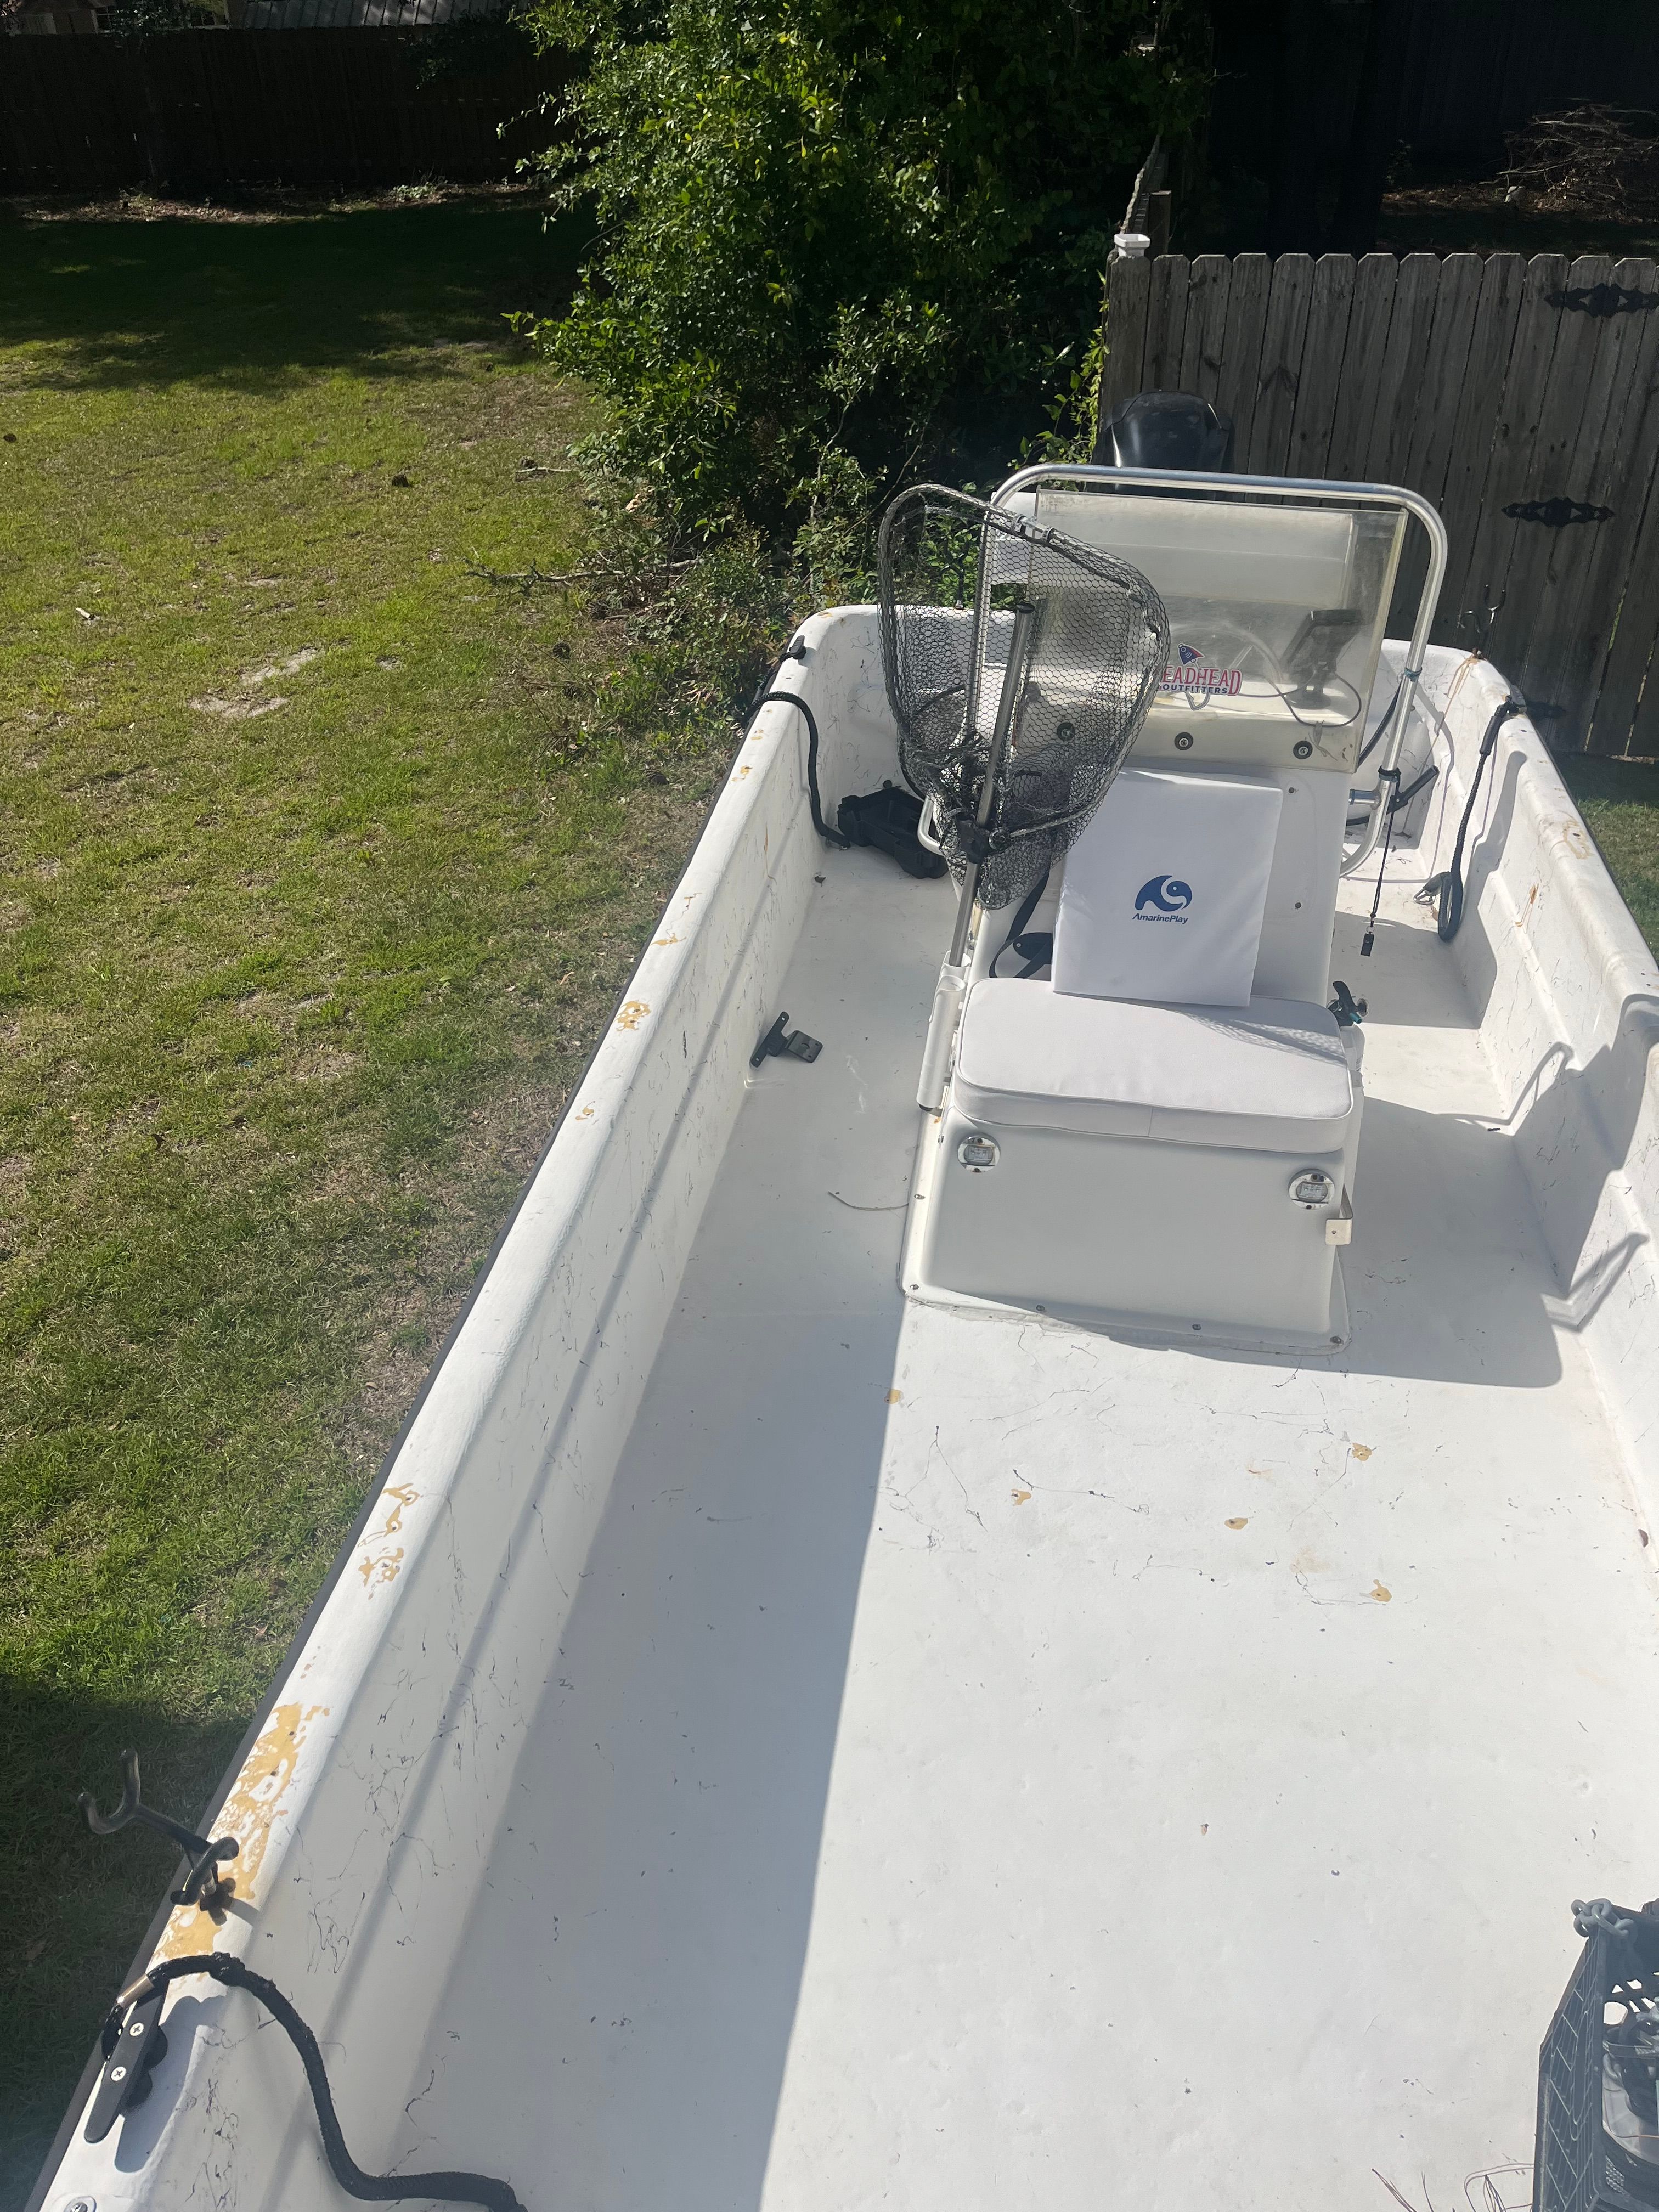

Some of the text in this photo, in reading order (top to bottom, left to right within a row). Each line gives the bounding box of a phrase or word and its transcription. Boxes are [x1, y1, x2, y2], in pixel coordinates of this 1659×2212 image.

[1159, 666, 1242, 695] EADHEAD
[1163, 684, 1227, 694] OUTFITTERS
[1132, 913, 1189, 924] AmarinePlay
